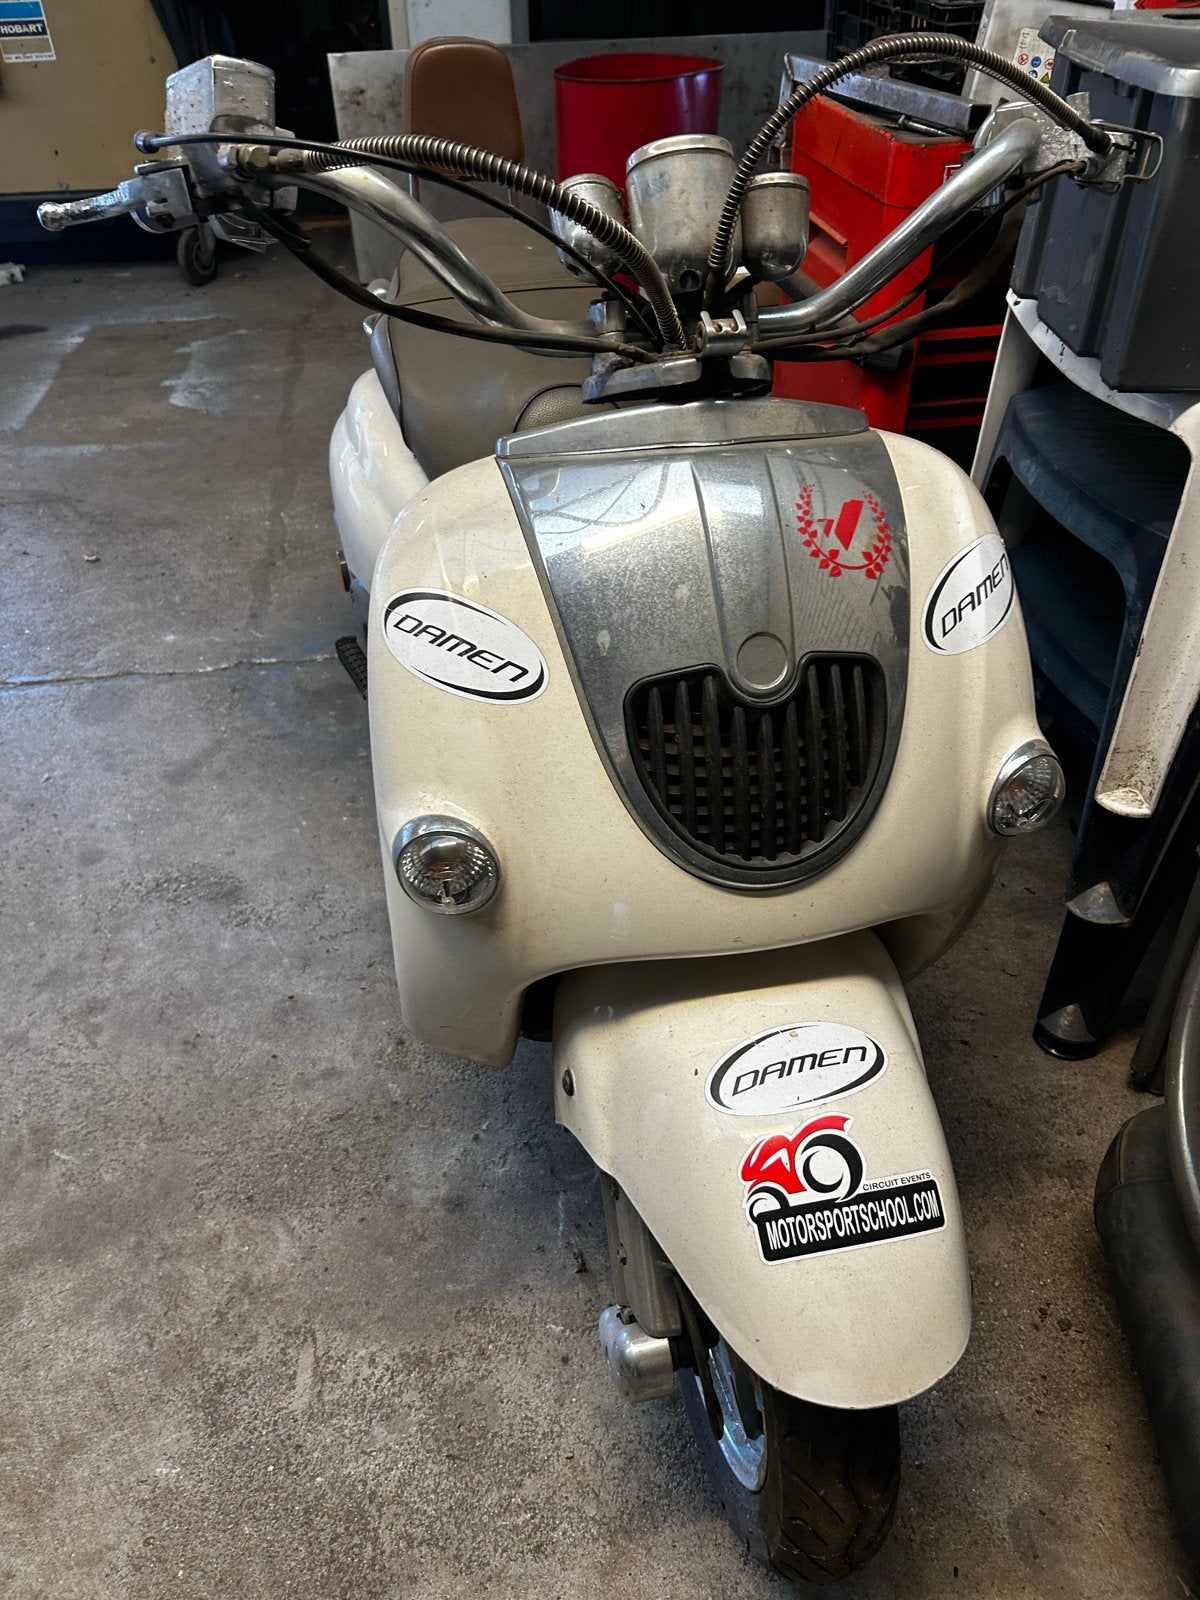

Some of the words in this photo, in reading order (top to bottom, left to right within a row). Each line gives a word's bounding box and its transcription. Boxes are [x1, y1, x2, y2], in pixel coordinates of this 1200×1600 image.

[0, 23, 43, 34] HOBART
[942, 553, 1009, 638] DAMEN
[393, 614, 529, 683] DAMEN
[732, 1046, 867, 1096] DAMEN
[862, 1179, 899, 1191] CIRCUIT
[901, 1172, 931, 1185] EVENTS
[766, 1189, 940, 1250] MOTORSPORTSCHOOL.COM
